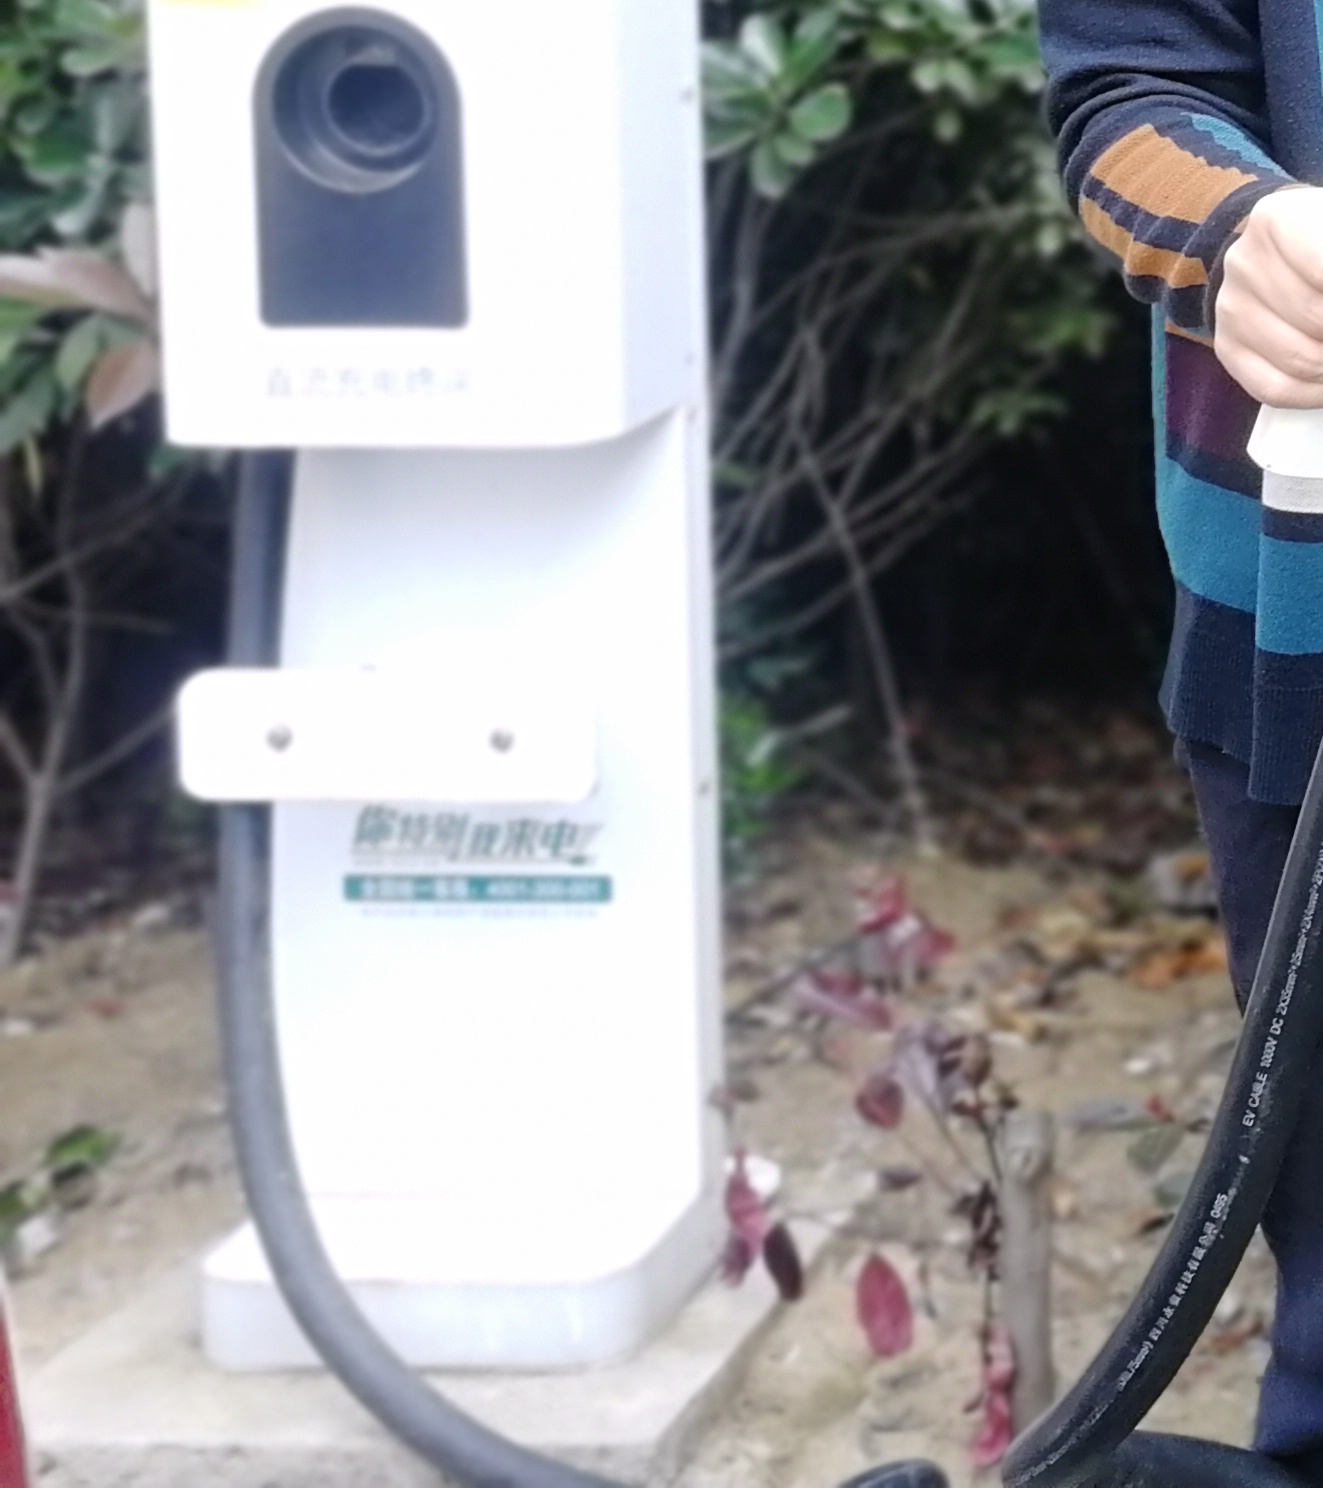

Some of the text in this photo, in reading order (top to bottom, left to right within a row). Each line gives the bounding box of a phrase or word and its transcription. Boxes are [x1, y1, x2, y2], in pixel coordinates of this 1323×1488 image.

[1268, 1016, 1285, 1035] DC
[1246, 1069, 1269, 1109] CABLE
[1240, 1108, 1257, 1128] EV
